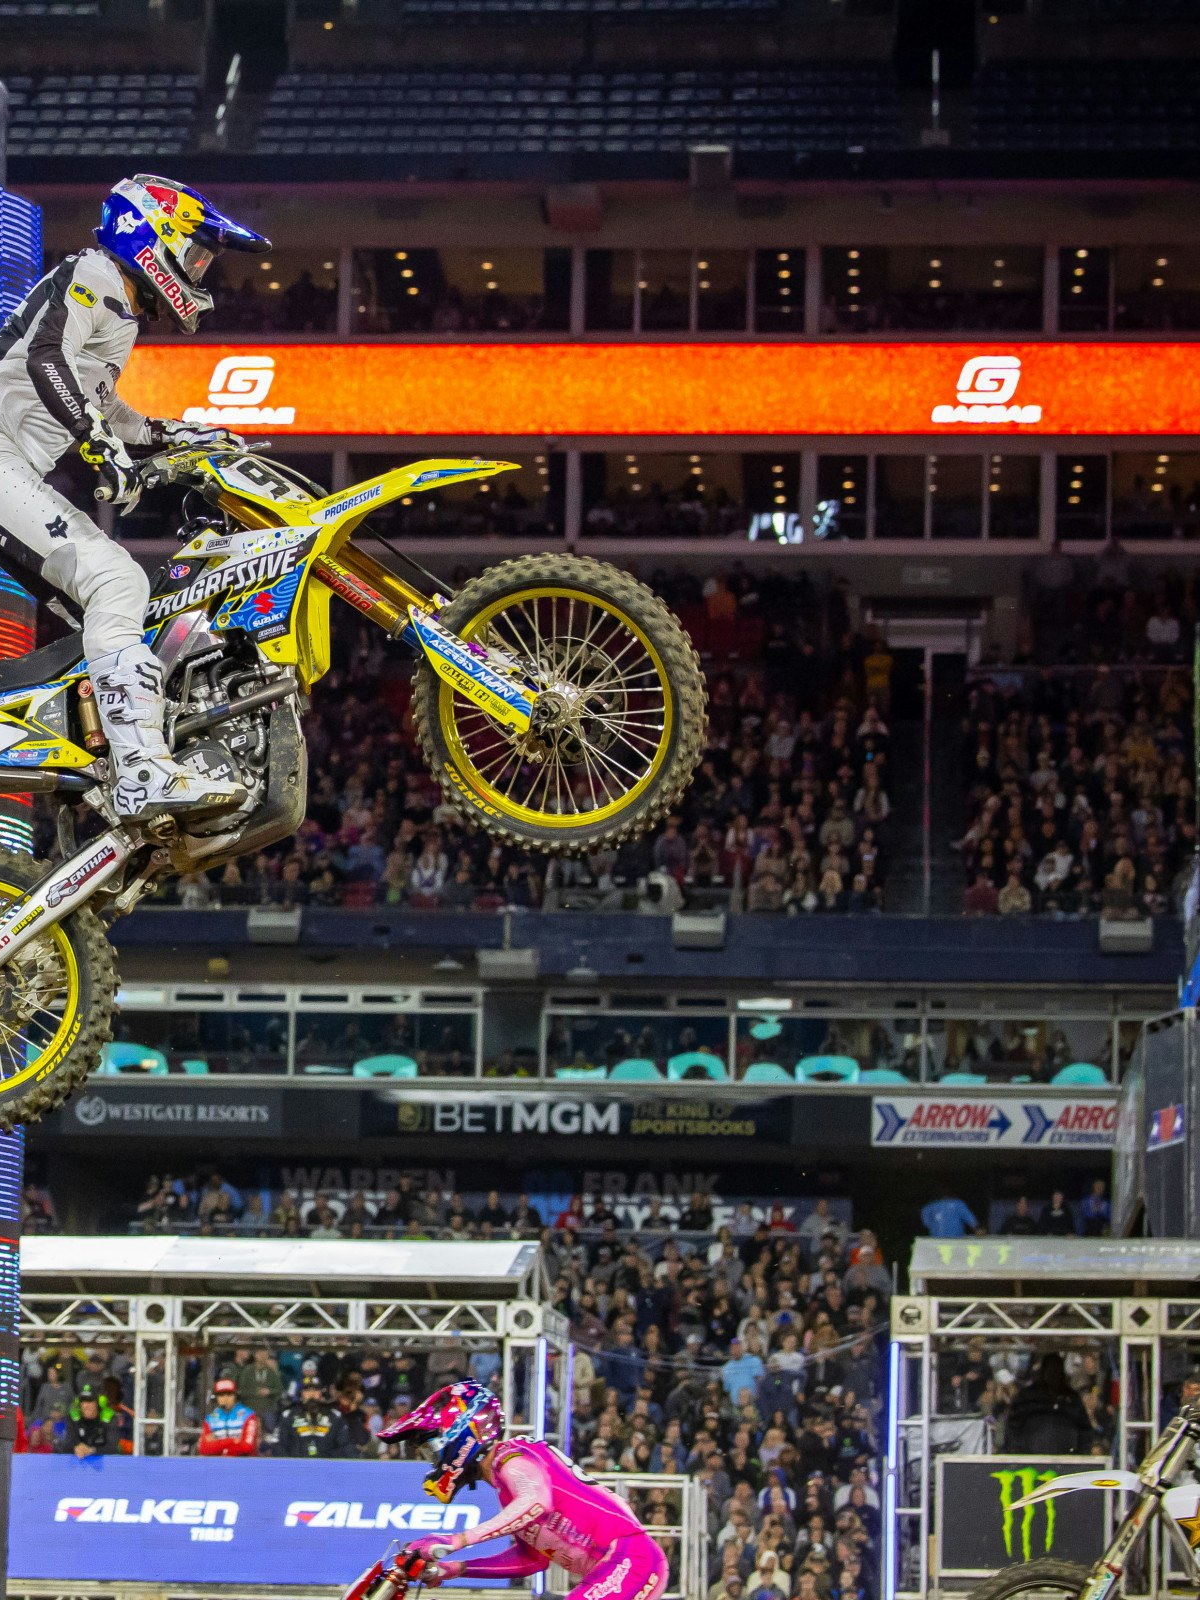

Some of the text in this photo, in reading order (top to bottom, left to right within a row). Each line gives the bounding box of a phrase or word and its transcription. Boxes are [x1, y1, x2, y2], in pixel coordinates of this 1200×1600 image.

[42, 362, 82, 420] PROGRESSIV
[324, 485, 382, 520] PROGRESSIVE
[144, 547, 299, 620] PROGRESSIVE
[317, 568, 372, 611] SHOWA
[253, 612, 283, 628] SUZUKI
[428, 639, 474, 672] ACERBIS
[99, 693, 127, 705] FOX
[206, 795, 232, 803] FOX
[46, 846, 115, 908] RENTHAL
[35, 1021, 82, 1082] DUNLOP
[108, 1103, 269, 1122] WESTGATE RESORTS
[634, 1103, 734, 1118] THE KING OF
[905, 1104, 995, 1129] ARROW
[1054, 1104, 1118, 1131] ARRO
[631, 1119, 755, 1136] SPORTSBOOKS
[54, 1498, 240, 1525] FALKEN
[284, 1501, 481, 1531] FALKEN
[191, 1528, 234, 1543] TIRES
